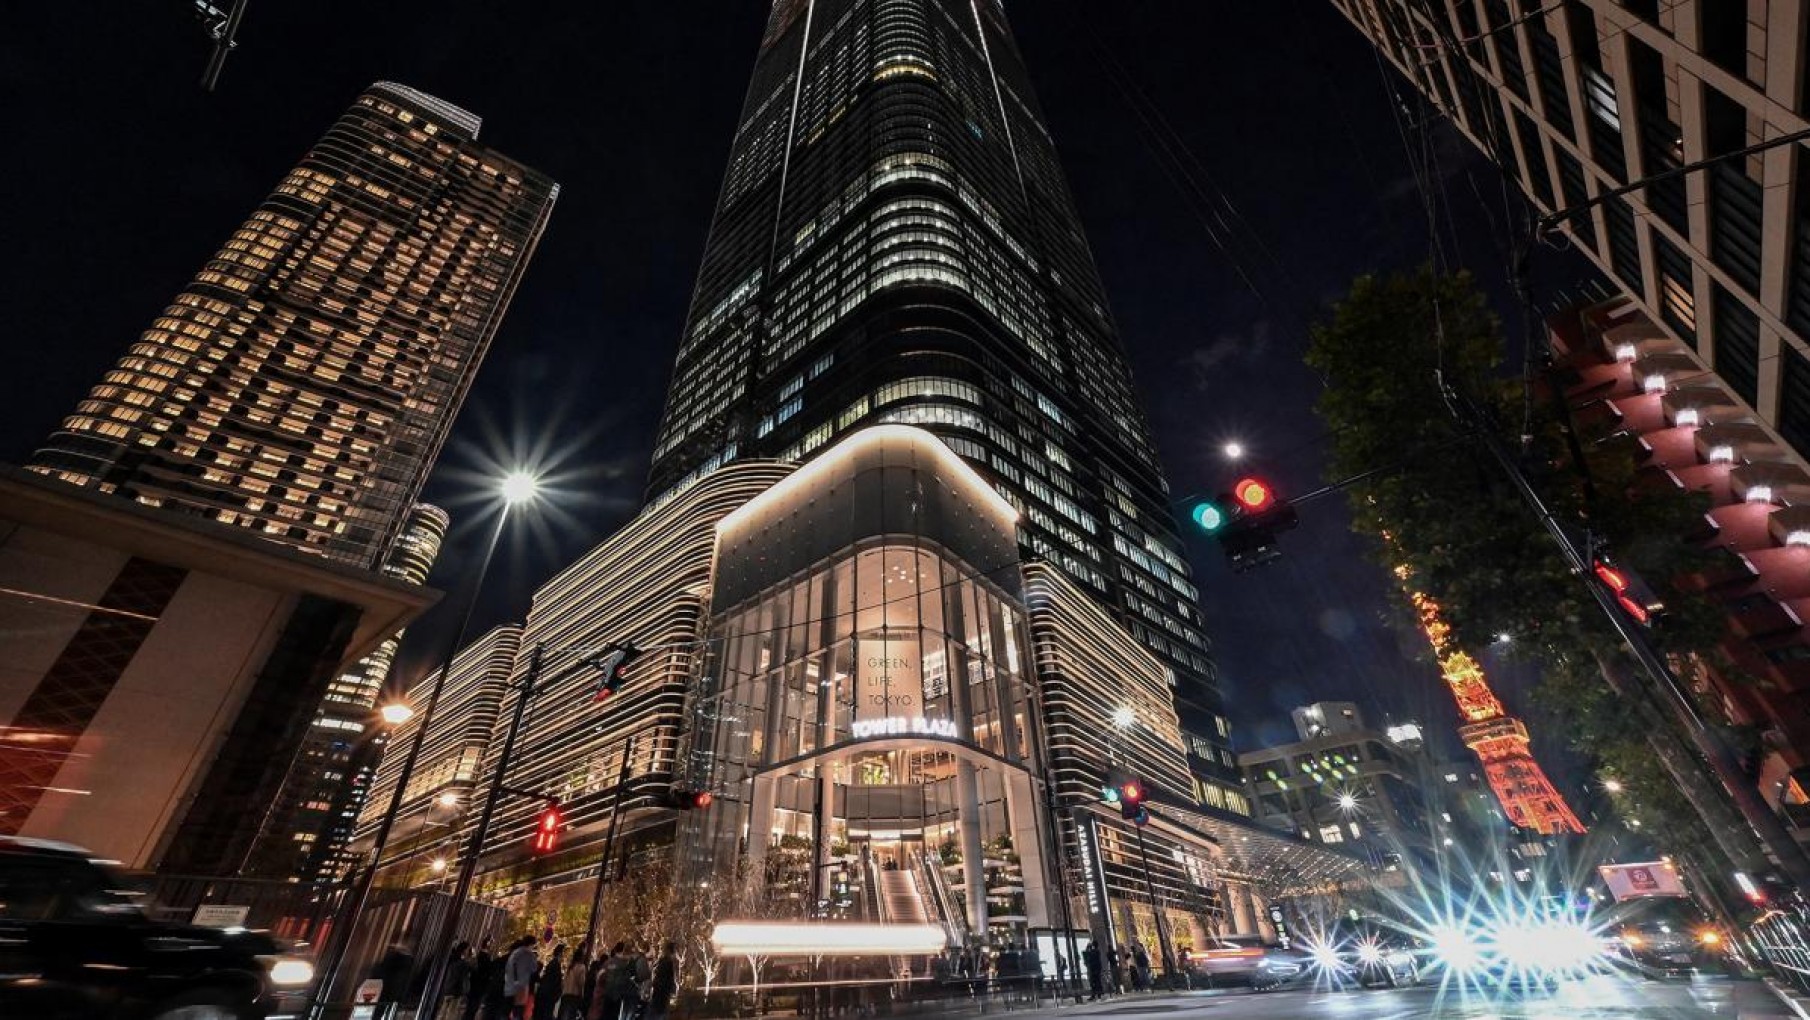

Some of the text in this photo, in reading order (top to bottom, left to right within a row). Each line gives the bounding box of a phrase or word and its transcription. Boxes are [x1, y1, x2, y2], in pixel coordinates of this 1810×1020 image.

[852, 717, 958, 738] TOWER PLAZA
[1077, 824, 1099, 914] AZABUDAI HILLS
